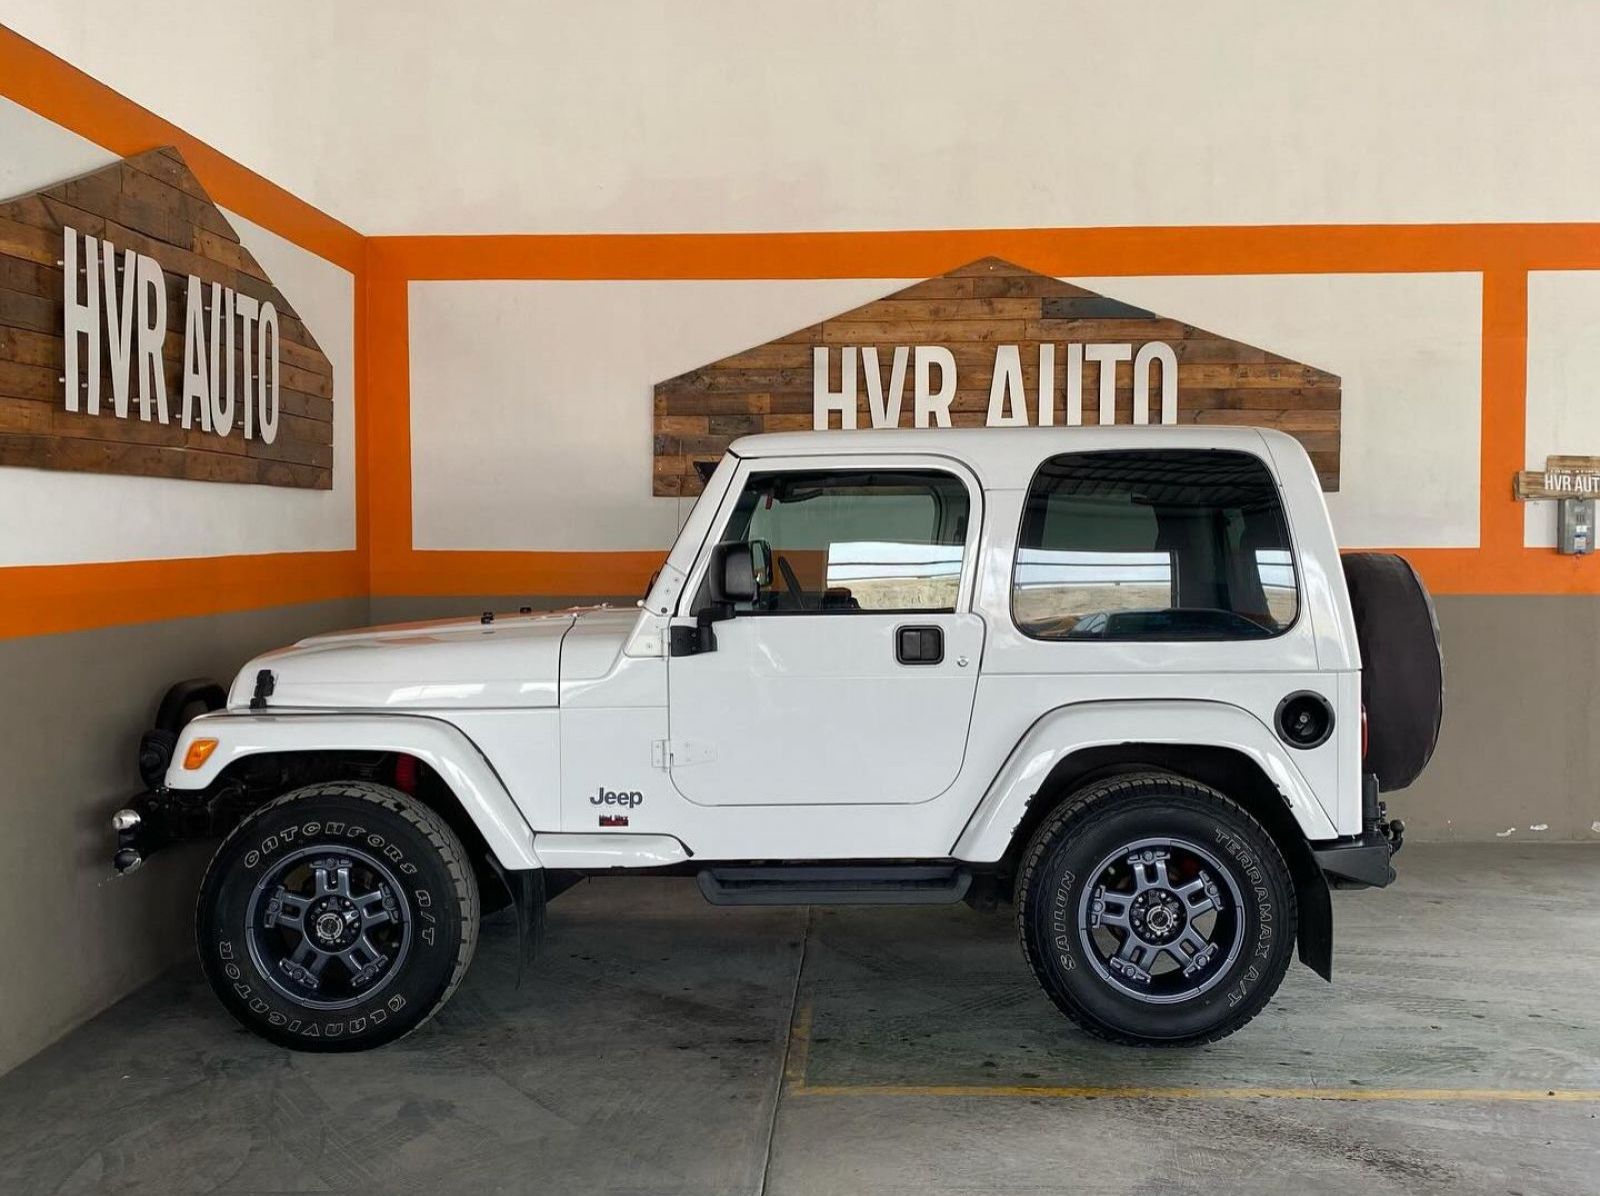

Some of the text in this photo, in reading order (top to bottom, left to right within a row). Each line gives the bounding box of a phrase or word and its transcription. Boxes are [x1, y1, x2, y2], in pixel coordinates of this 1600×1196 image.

[64, 225, 279, 444] HVR AUTO
[812, 341, 1179, 430] HVR AUTO
[1544, 474, 1571, 491] HVR
[590, 787, 643, 808] Jeep
[1054, 870, 1076, 971] SAILUN
[1214, 827, 1272, 1008] TERRAMAX A/T
